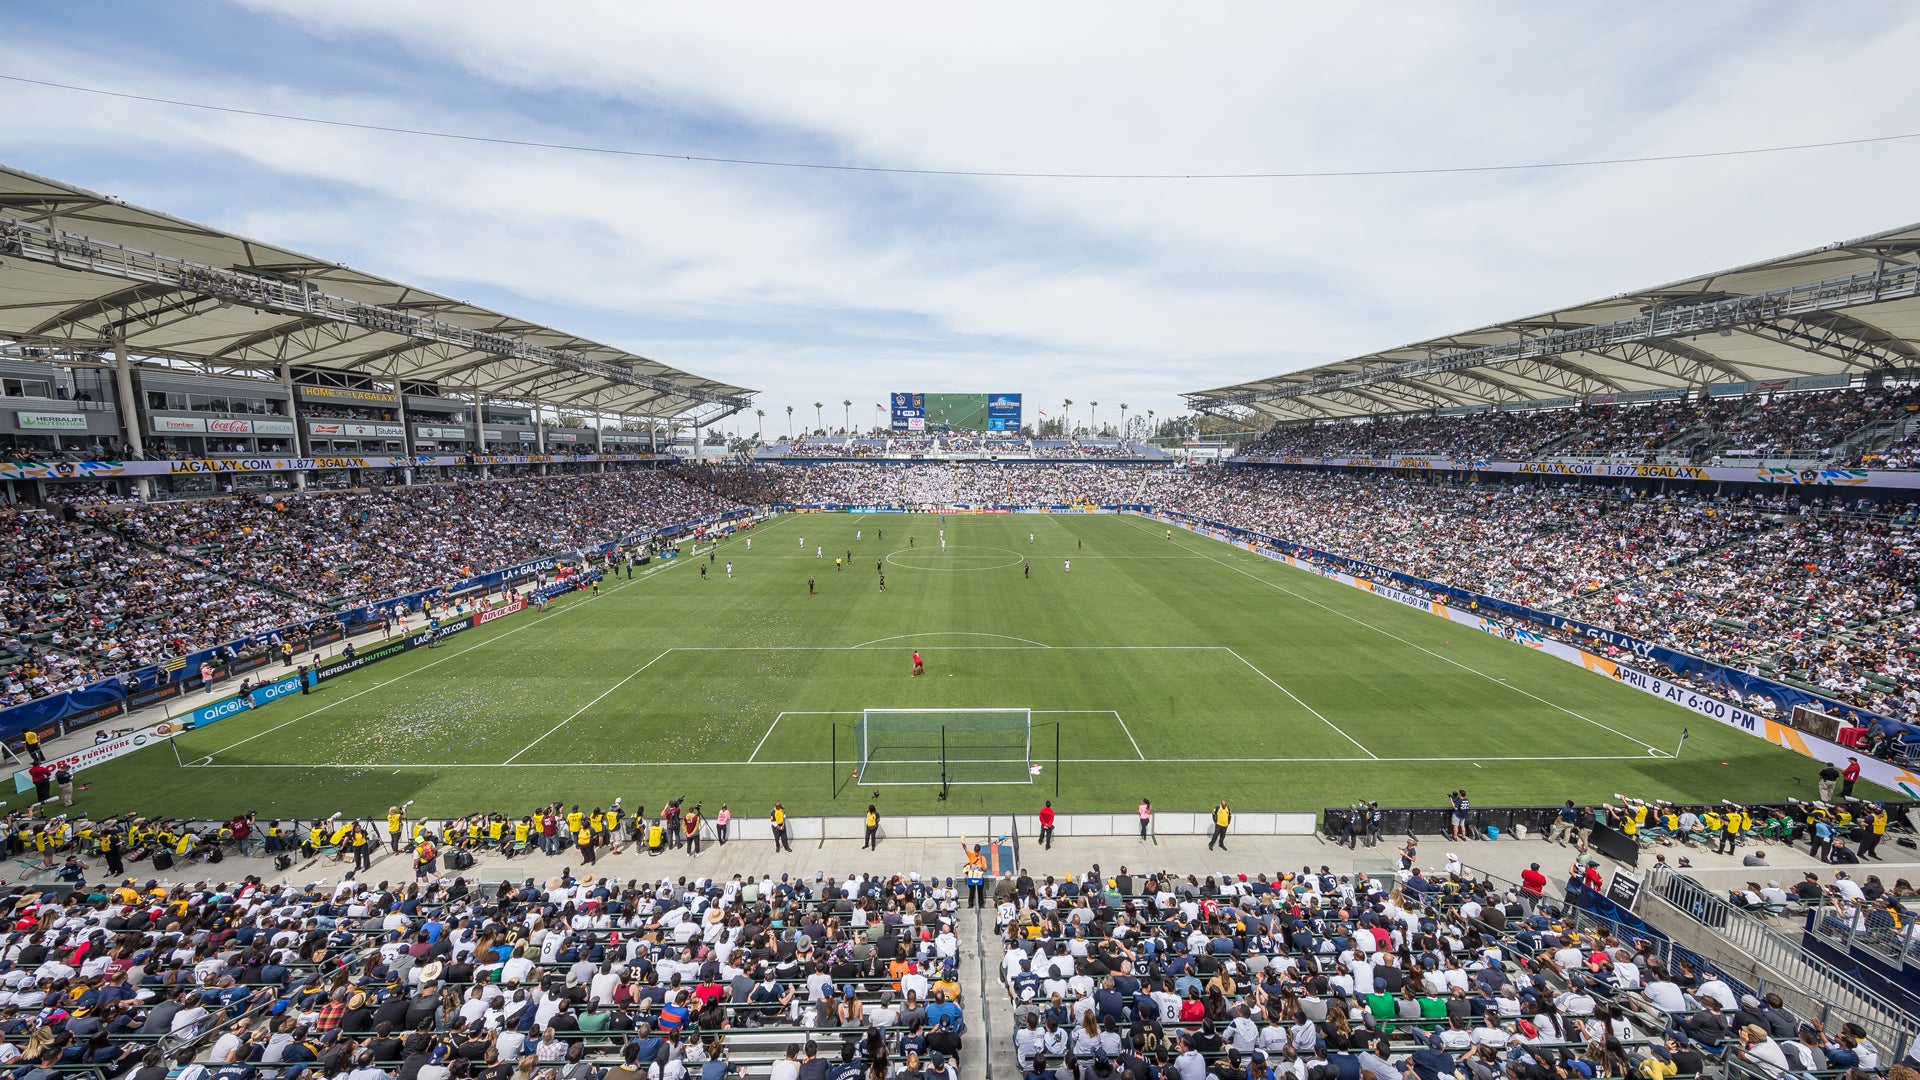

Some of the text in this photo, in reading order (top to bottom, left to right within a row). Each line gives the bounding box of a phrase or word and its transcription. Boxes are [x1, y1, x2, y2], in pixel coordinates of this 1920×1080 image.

[306, 387, 334, 397] HOME
[166, 420, 194, 429] Frontier
[210, 420, 248, 432] Coca-Cola
[378, 426, 404, 435] StubHub
[287, 458, 364, 470] 1.877.3GALAXY
[1518, 464, 1702, 478] LAGALAXY.COM 1.877.3GALAXY
[501, 560, 550, 580] LA GALAXY
[1370, 583, 1430, 611] APRIL 8 AT 6:00 PM
[481, 601, 522, 624] ADVOCARE
[1586, 628, 1655, 658] GALAXY
[318, 644, 404, 678] HERBALIFE NUTRITION
[265, 678, 302, 698] alcate
[1612, 666, 1756, 731] APRIL 8 AT 6:00 PM
[204, 698, 250, 720] alcate
[45, 756, 80, 773] OB'S
[82, 739, 130, 761] FURNITURE
[725, 884, 734, 895] 10
[913, 890, 922, 899] 16
[1003, 908, 1014, 920] 24
[505, 930, 518, 942] 10
[544, 942, 552, 954] 8
[195, 971, 210, 984] 10
[630, 966, 641, 979] 23
[1166, 1005, 1175, 1020] 8
[1623, 1027, 1630, 1040] 8
[1143, 1033, 1158, 1050] 10
